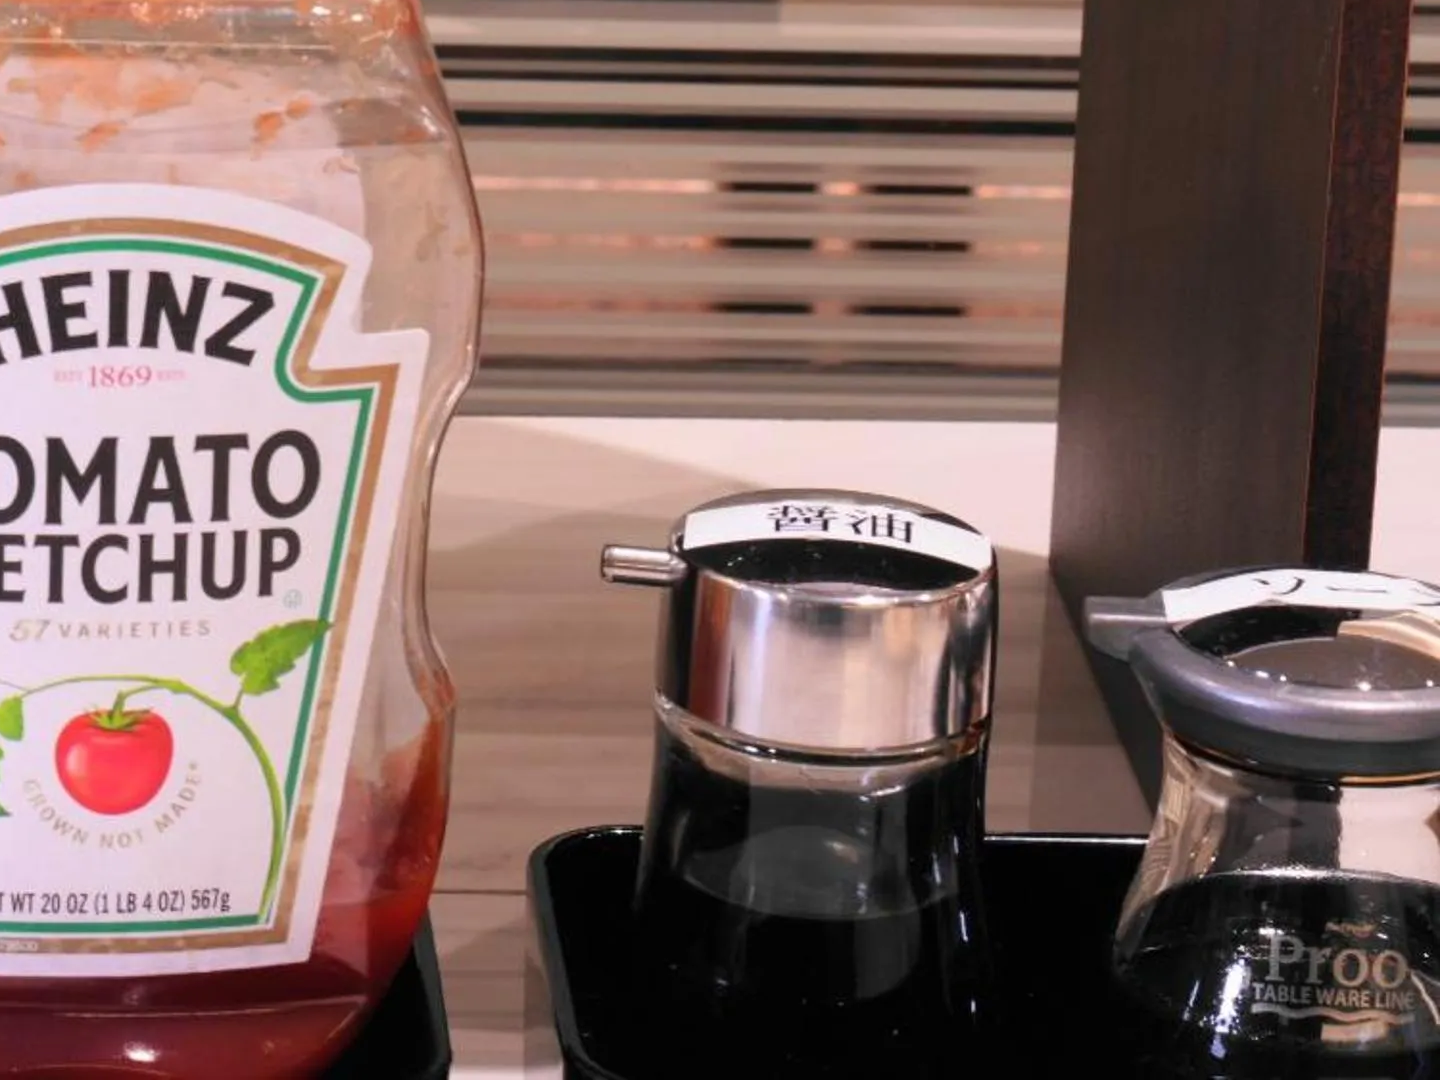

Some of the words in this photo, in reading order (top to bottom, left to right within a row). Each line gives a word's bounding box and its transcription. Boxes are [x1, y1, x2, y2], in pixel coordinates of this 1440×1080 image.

[90, 365, 152, 388] 1869
[9, 619, 51, 642] 57
[59, 619, 212, 640] VARIETIES
[23, 778, 89, 845] GROWN
[99, 828, 144, 850] NOT
[10, 892, 35, 914] WT
[41, 893, 60, 914] 20
[66, 893, 88, 914] OZ
[94, 892, 110, 915] (1
[116, 893, 137, 914] LB
[142, 892, 153, 913] 4
[158, 890, 186, 913] OZ)
[190, 888, 232, 912] 567g
[1252, 982, 1311, 1003] TABLE
[1315, 987, 1369, 1007] WARE
[1375, 990, 1415, 1010] LINE
